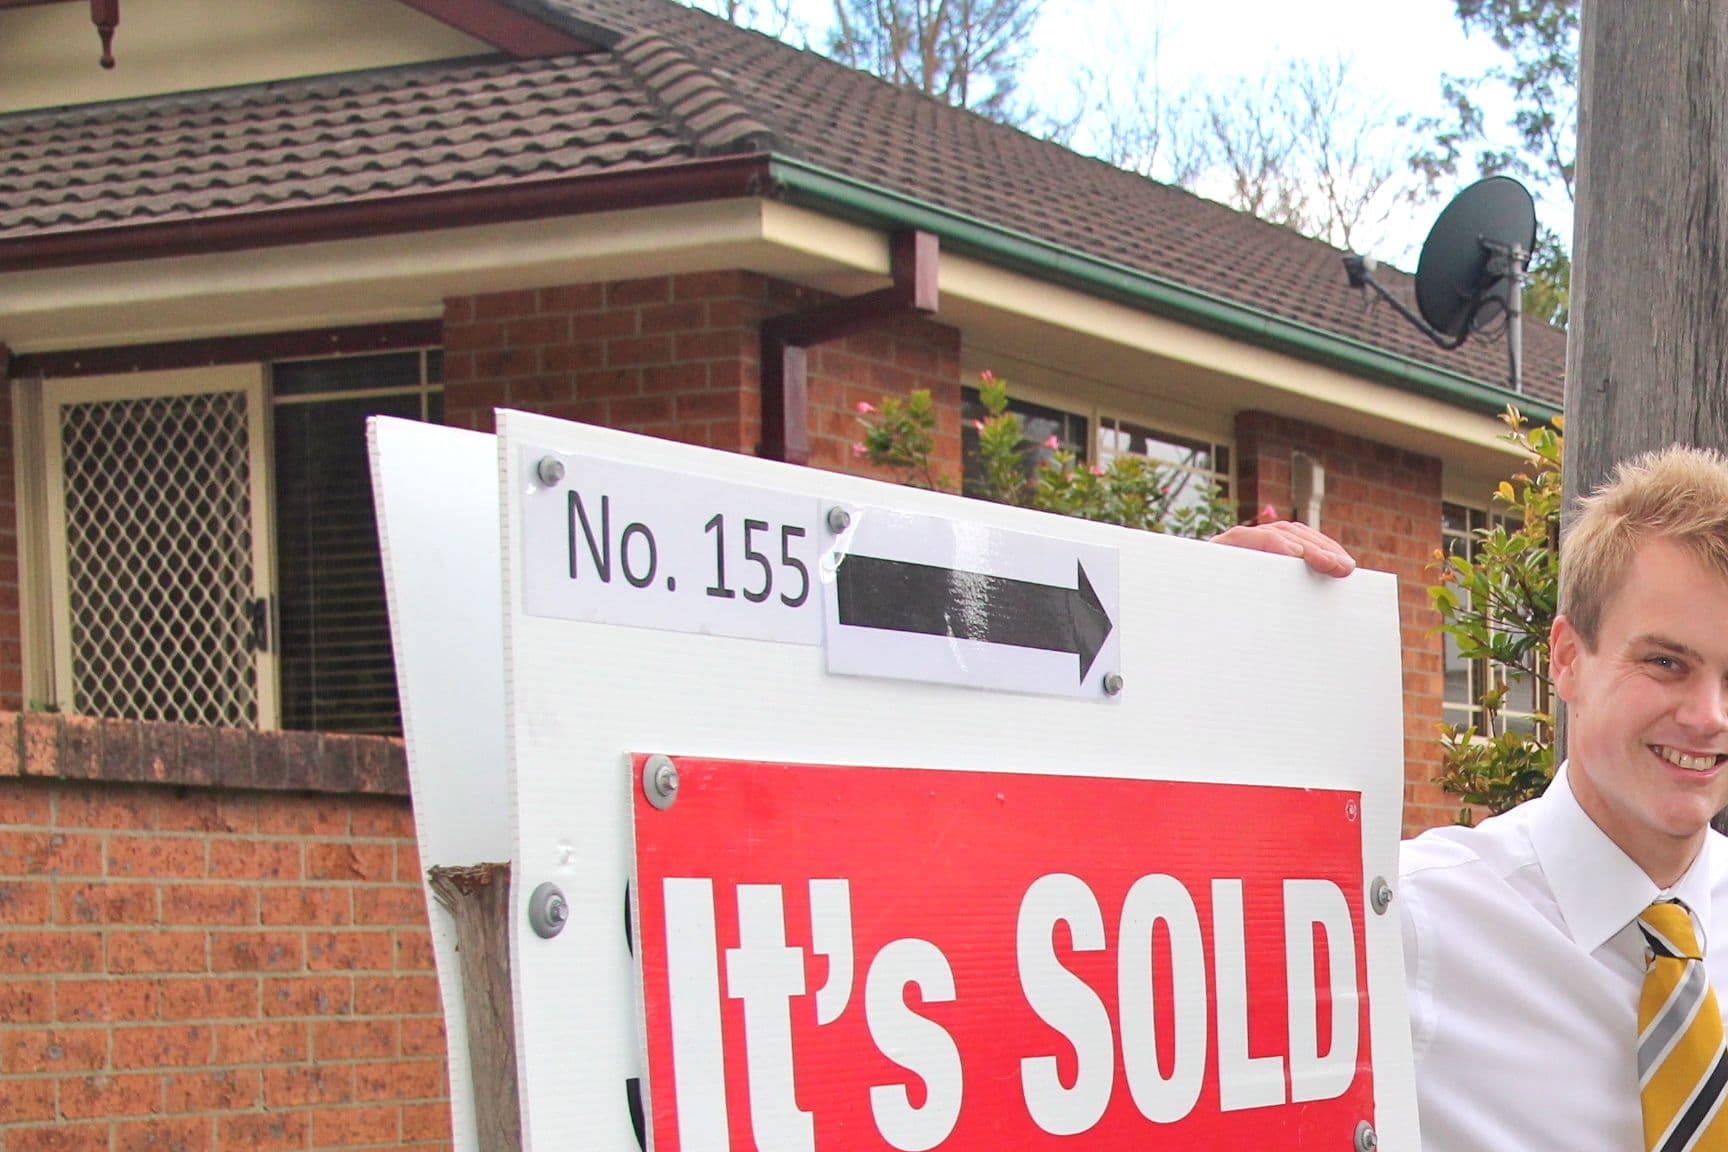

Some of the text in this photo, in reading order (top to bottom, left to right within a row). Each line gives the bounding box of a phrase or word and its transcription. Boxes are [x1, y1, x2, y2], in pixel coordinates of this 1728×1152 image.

[567, 489, 811, 608] No. 155
[1015, 872, 1361, 1137] SOLD
